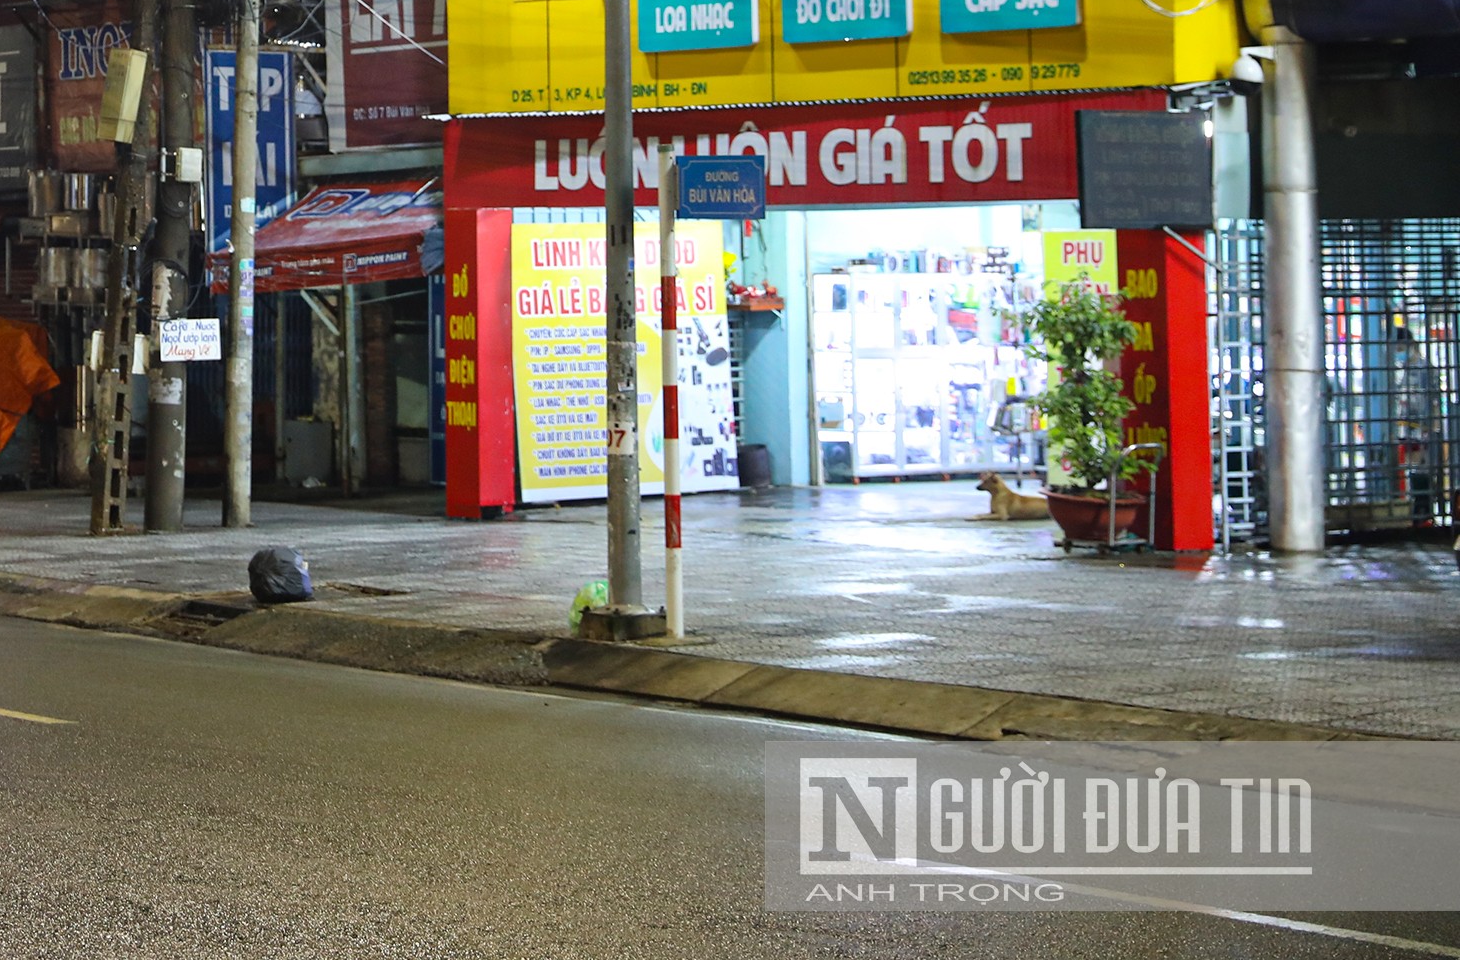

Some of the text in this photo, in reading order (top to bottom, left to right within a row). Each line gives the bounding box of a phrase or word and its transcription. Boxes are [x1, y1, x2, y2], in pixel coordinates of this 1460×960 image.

[656, 1, 735, 36] LOA NHẠC
[213, 66, 283, 113] TP
[664, 84, 679, 96] BH
[819, 115, 907, 186] GIÁ
[919, 101, 1033, 183] TỐT
[689, 186, 707, 203] BÙI
[708, 186, 731, 202] VĂN
[533, 241, 582, 267] LINH
[1062, 242, 1103, 269] PHỤ
[452, 264, 469, 298] ĐỒ
[518, 283, 554, 316] GIÁ
[558, 278, 582, 314] LẺ
[696, 276, 714, 311] SỈ
[1126, 268, 1158, 299] BAO
[449, 312, 476, 340] CHƠI
[449, 355, 476, 388] ĐIỆN
[1133, 362, 1157, 405] ỐP
[446, 401, 477, 432] THOẠI
